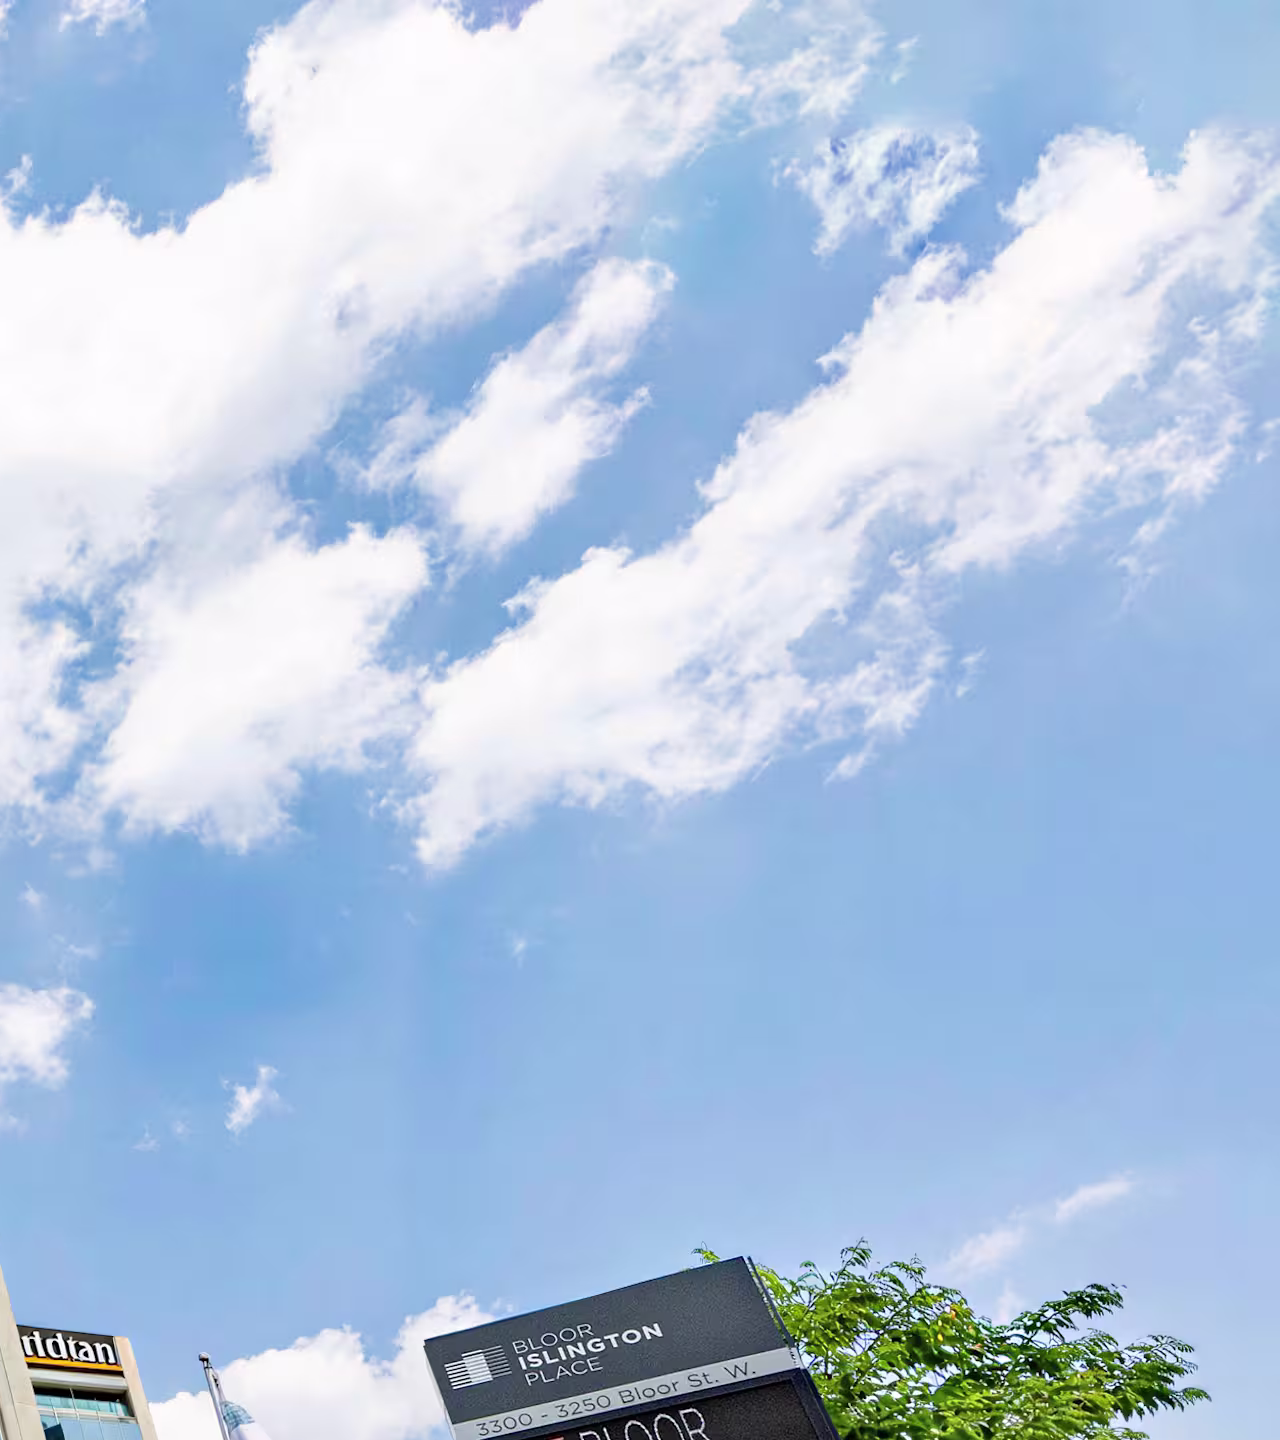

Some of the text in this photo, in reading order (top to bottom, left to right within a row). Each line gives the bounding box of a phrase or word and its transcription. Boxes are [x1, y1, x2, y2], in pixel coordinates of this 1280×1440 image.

[512, 1323, 593, 1354] BLOOR
[518, 1322, 663, 1371] ISLINGTON
[524, 1356, 604, 1387] PLACE
[476, 1412, 533, 1437] 3300
[555, 1394, 612, 1419] 3250
[618, 1379, 680, 1404] Bloor
[687, 1370, 719, 1390] St.
[723, 1361, 756, 1380] W.
